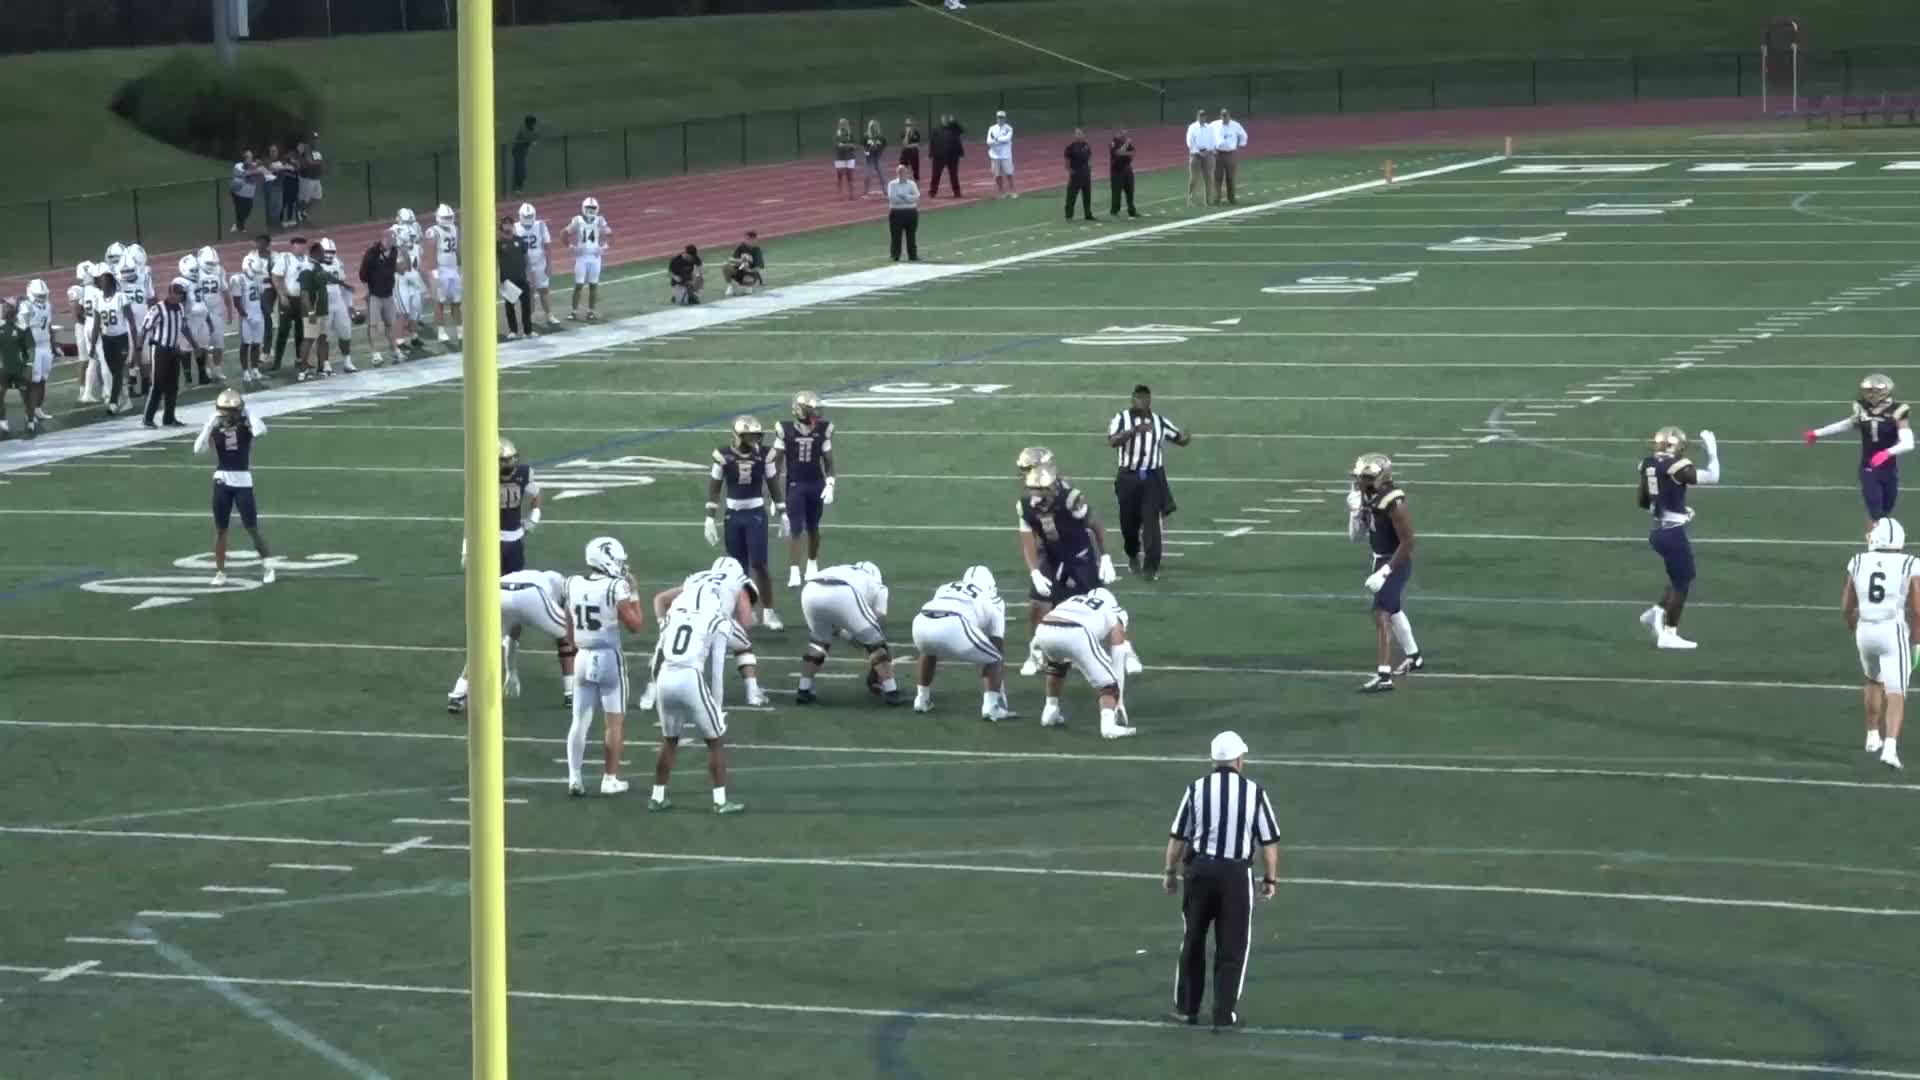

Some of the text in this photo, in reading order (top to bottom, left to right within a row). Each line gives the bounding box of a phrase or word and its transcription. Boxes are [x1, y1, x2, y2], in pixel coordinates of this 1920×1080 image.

[101, 309, 118, 327] 26
[1868, 571, 1886, 603] 6
[576, 604, 601, 631] 15
[672, 624, 693, 655] 0
